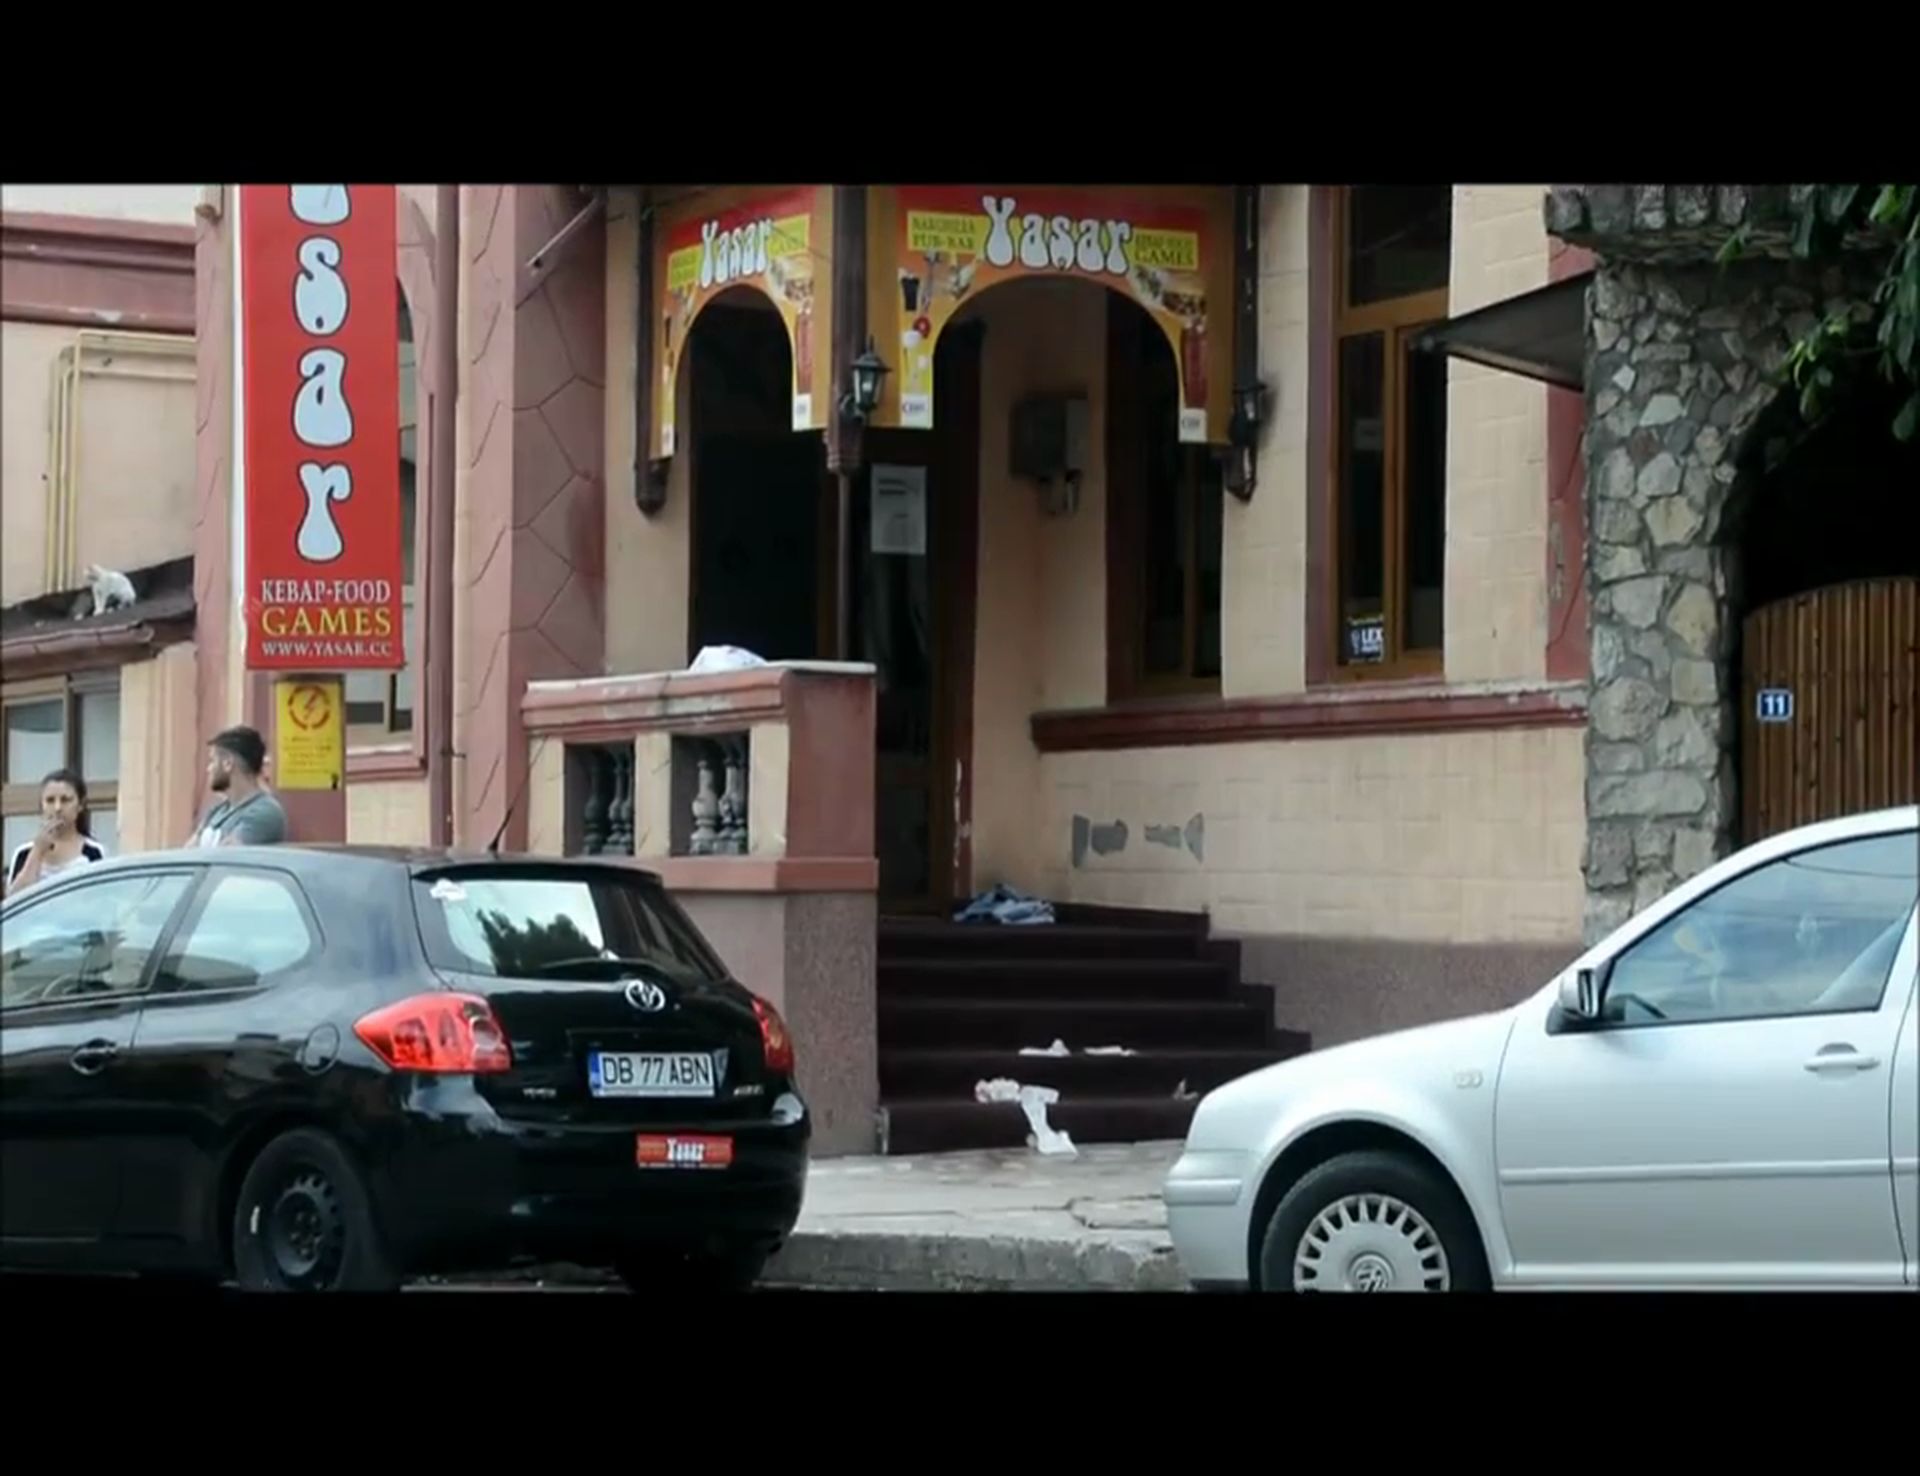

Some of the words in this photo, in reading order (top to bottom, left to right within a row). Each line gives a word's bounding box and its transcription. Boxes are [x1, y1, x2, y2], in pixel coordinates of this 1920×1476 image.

[261, 606, 391, 637] GAMES
[261, 641, 392, 657] WWW.YASAR.CC
[1764, 695, 1785, 715] 11
[602, 1056, 634, 1084] DB
[640, 1057, 665, 1084] 77
[669, 1056, 710, 1085] ABN
